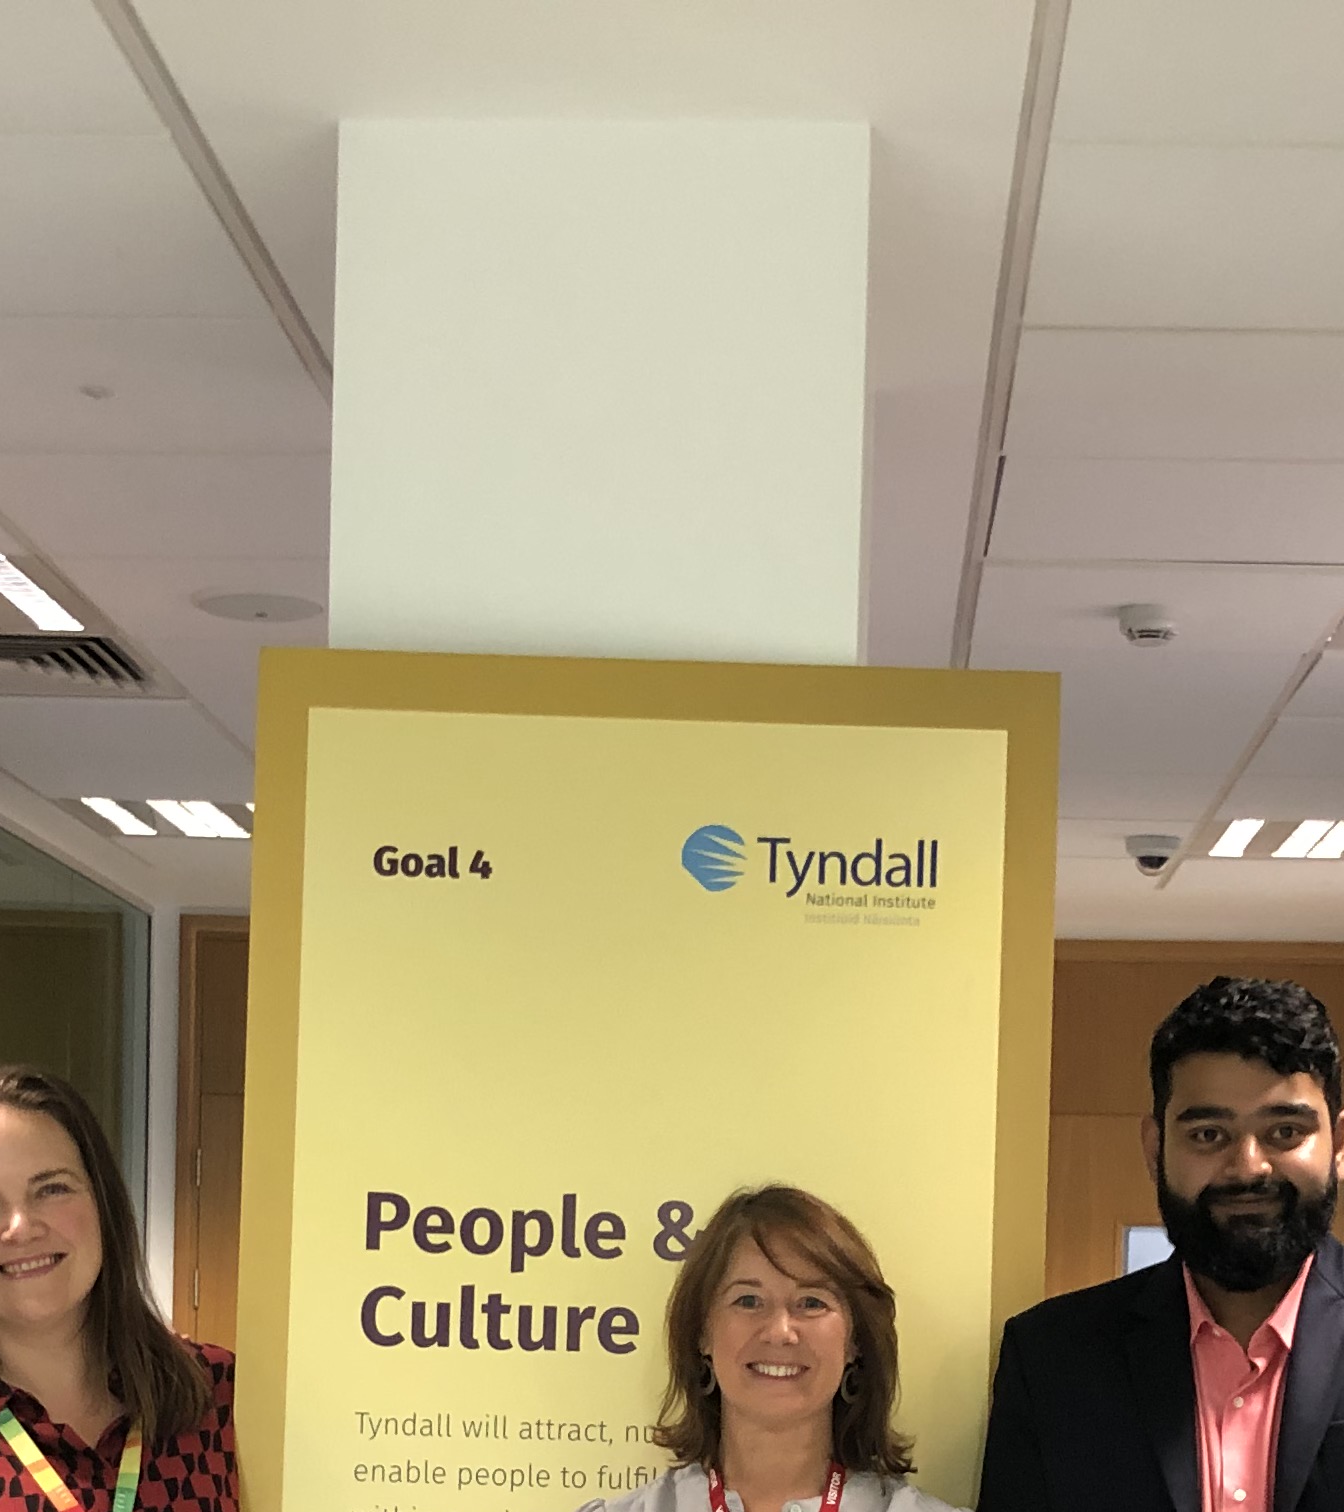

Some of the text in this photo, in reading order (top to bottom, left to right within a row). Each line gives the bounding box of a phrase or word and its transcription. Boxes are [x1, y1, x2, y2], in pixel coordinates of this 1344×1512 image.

[372, 844, 494, 881] Goal 4
[756, 836, 939, 899] Tyndall
[805, 892, 937, 911] National Institute
[365, 1190, 700, 1275] People &
[360, 1283, 640, 1356] Culture
[354, 1411, 452, 1441] Tyndall
[461, 1413, 509, 1440] will
[518, 1418, 614, 1447] attract,
[353, 1458, 447, 1485] enable
[457, 1462, 551, 1493] people
[559, 1466, 587, 1489] to
[825, 1471, 842, 1506] VISITOR
